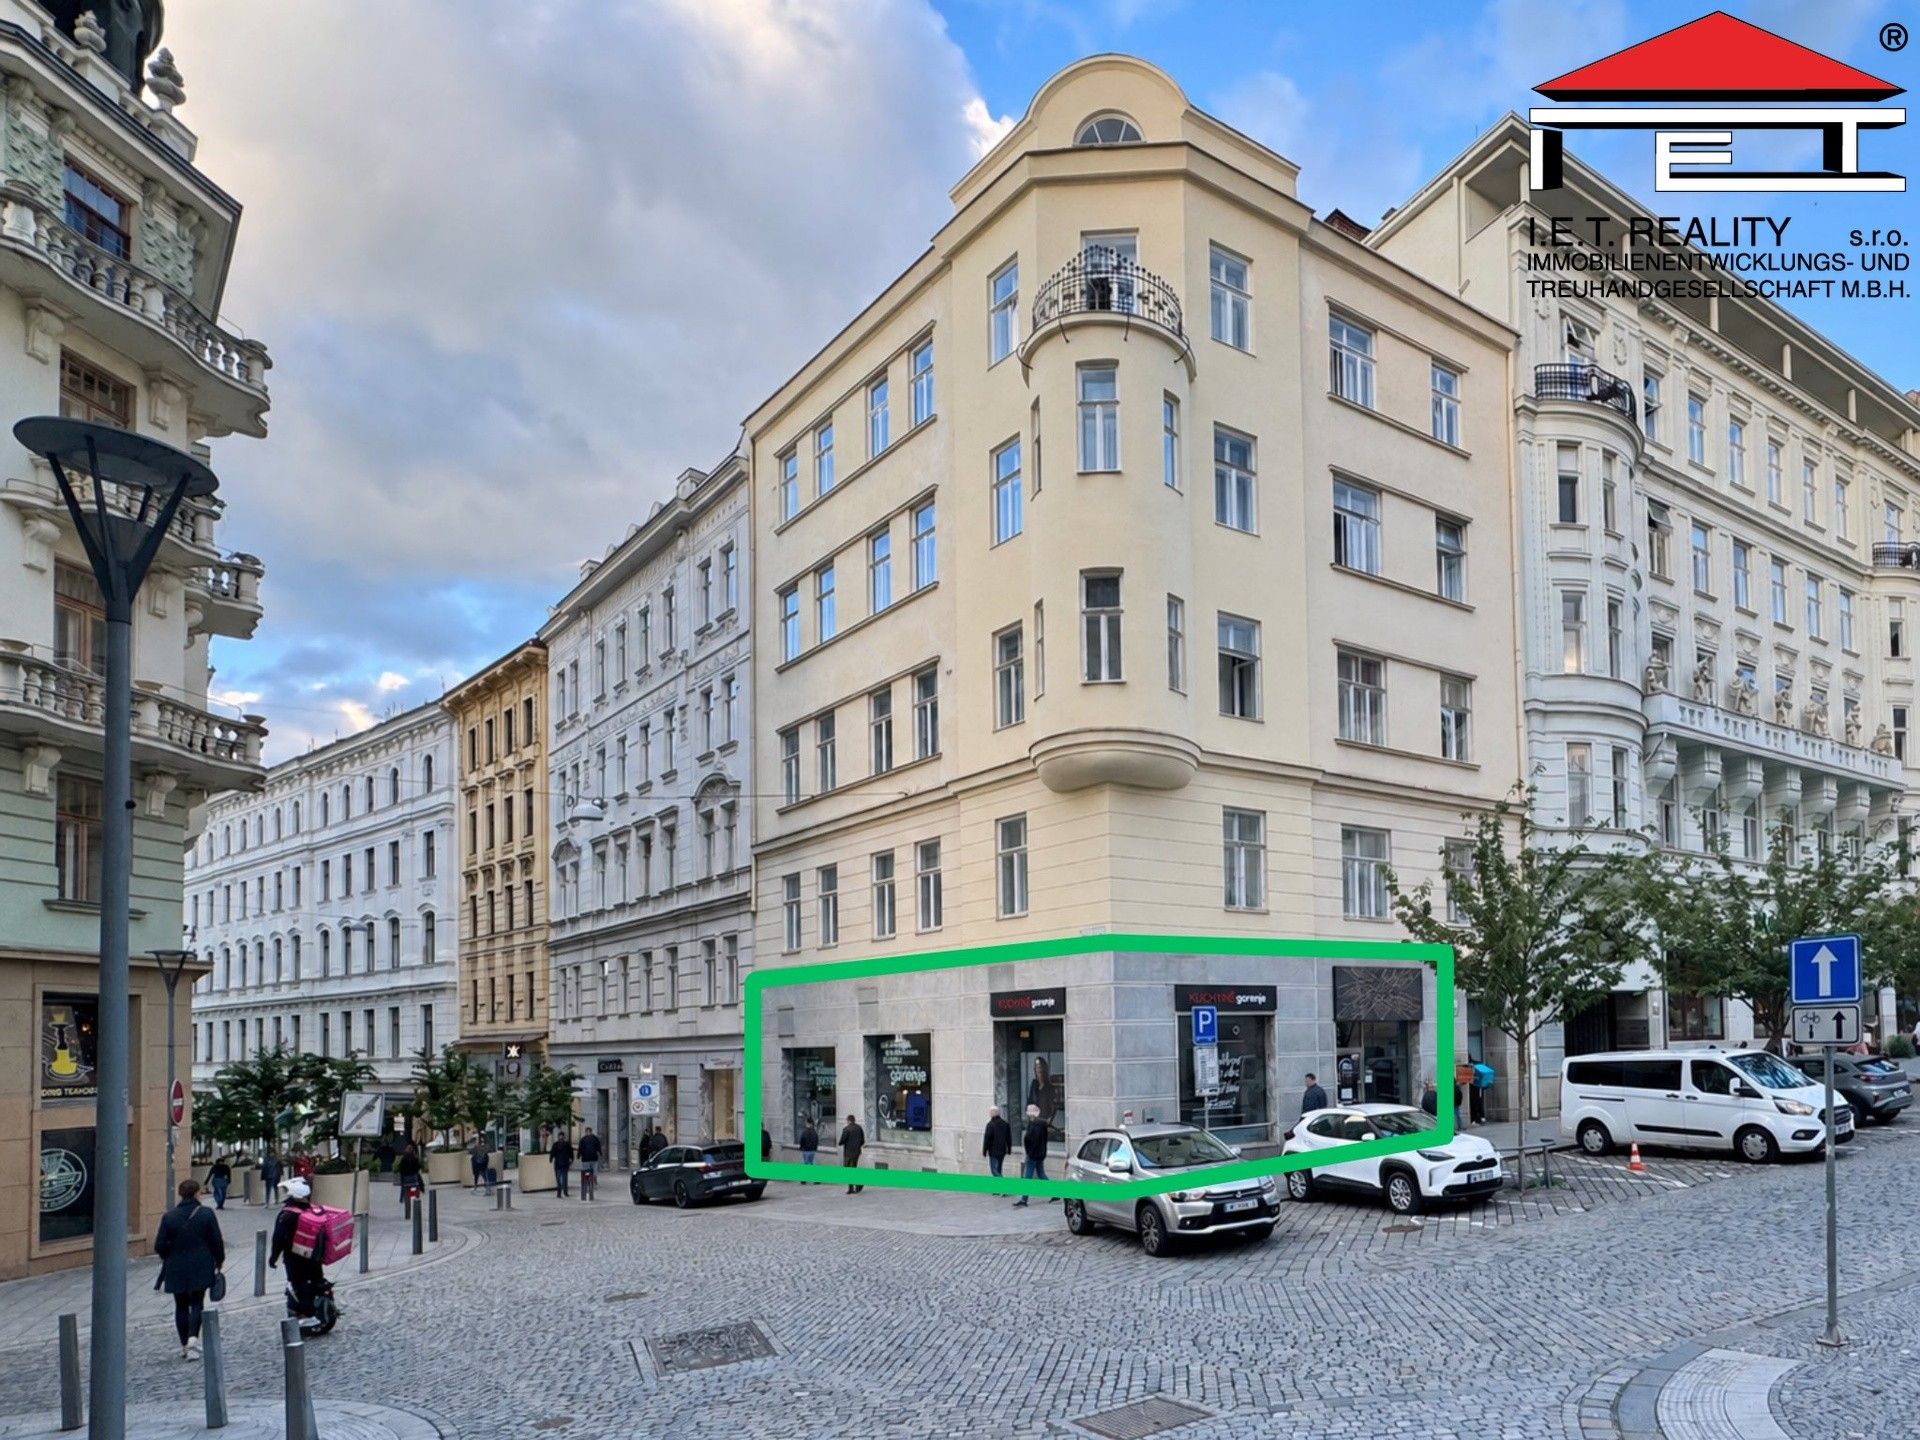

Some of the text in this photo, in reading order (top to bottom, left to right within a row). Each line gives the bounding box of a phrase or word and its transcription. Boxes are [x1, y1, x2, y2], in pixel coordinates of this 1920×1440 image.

[1235, 992, 1267, 1005] gorenje
[1198, 1010, 1212, 1034] P
[890, 1066, 927, 1086] gorenje
